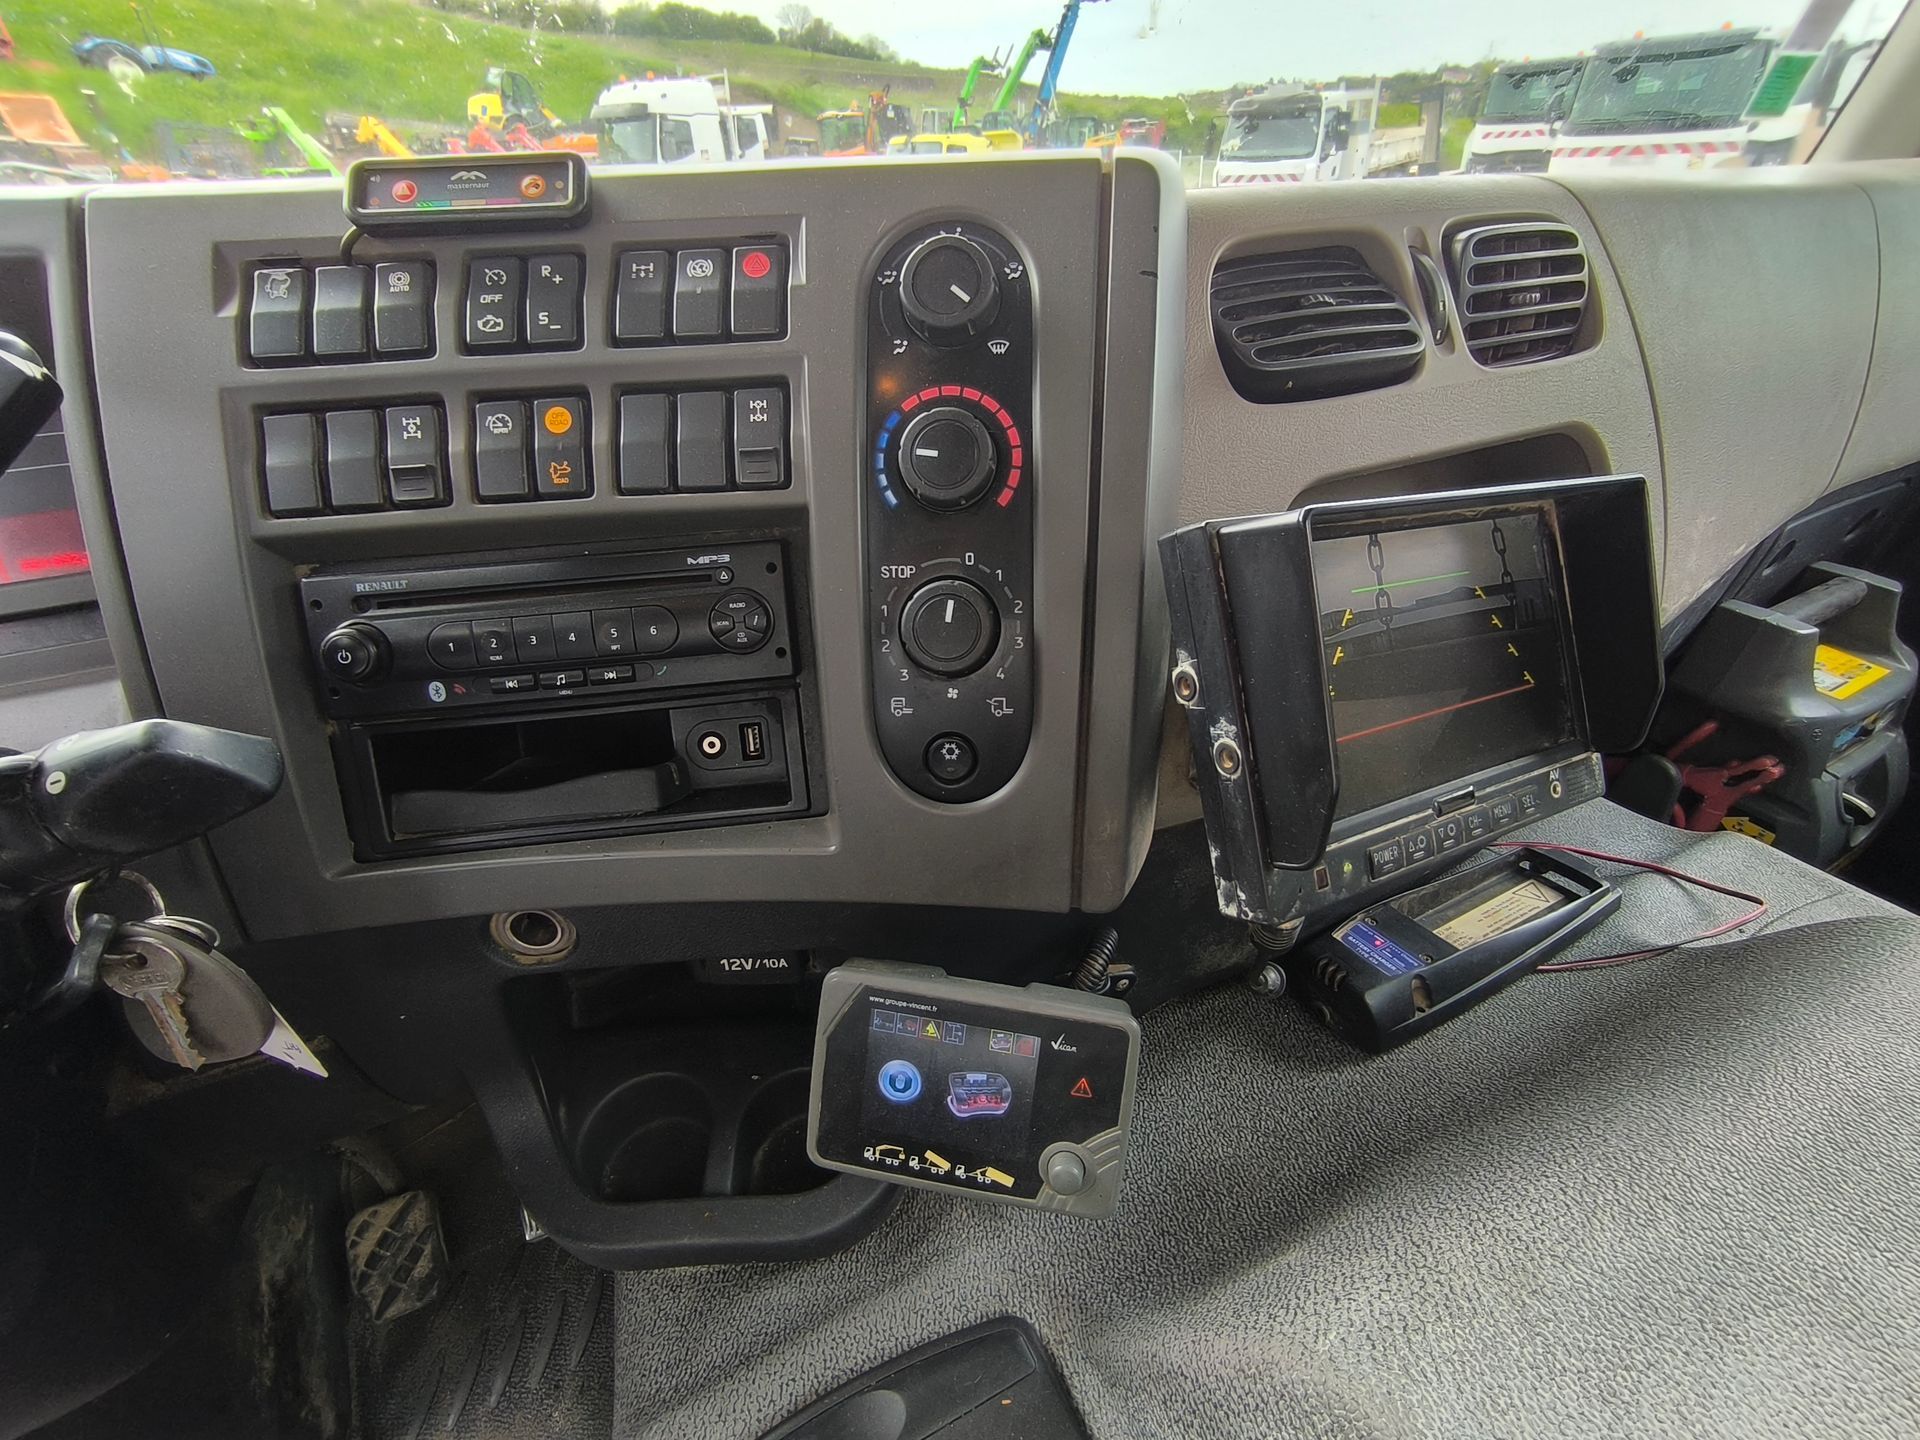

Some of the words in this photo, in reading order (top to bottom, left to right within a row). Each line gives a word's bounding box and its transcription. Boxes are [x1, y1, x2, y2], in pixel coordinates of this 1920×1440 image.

[389, 285, 410, 293] AUTO
[480, 294, 503, 304] OFF
[551, 412, 565, 420] OFF
[687, 554, 731, 565] MP3
[965, 552, 975, 566] 0
[880, 565, 916, 579] STOP
[995, 569, 1002, 582] 1
[355, 580, 409, 593] RENAULT
[881, 605, 888, 617] 1
[1013, 600, 1023, 614] 2
[448, 642, 455, 652] 1
[490, 638, 498, 648] 2
[529, 635, 537, 645] 3
[568, 632, 576, 642] 4
[610, 628, 618, 638] 5
[649, 625, 658, 635] 6
[1014, 636, 1024, 649] 3
[881, 639, 891, 652] 2
[900, 669, 909, 681] 3
[996, 667, 1005, 680] 4
[1549, 768, 1560, 782] AV
[1493, 802, 1512, 819] MENU
[1373, 846, 1399, 866] POWER
[1347, 936, 1372, 954] BATTERY
[1370, 949, 1397, 971] CHARGER
[869, 996, 938, 1012] www.groupe-vincent.fr
